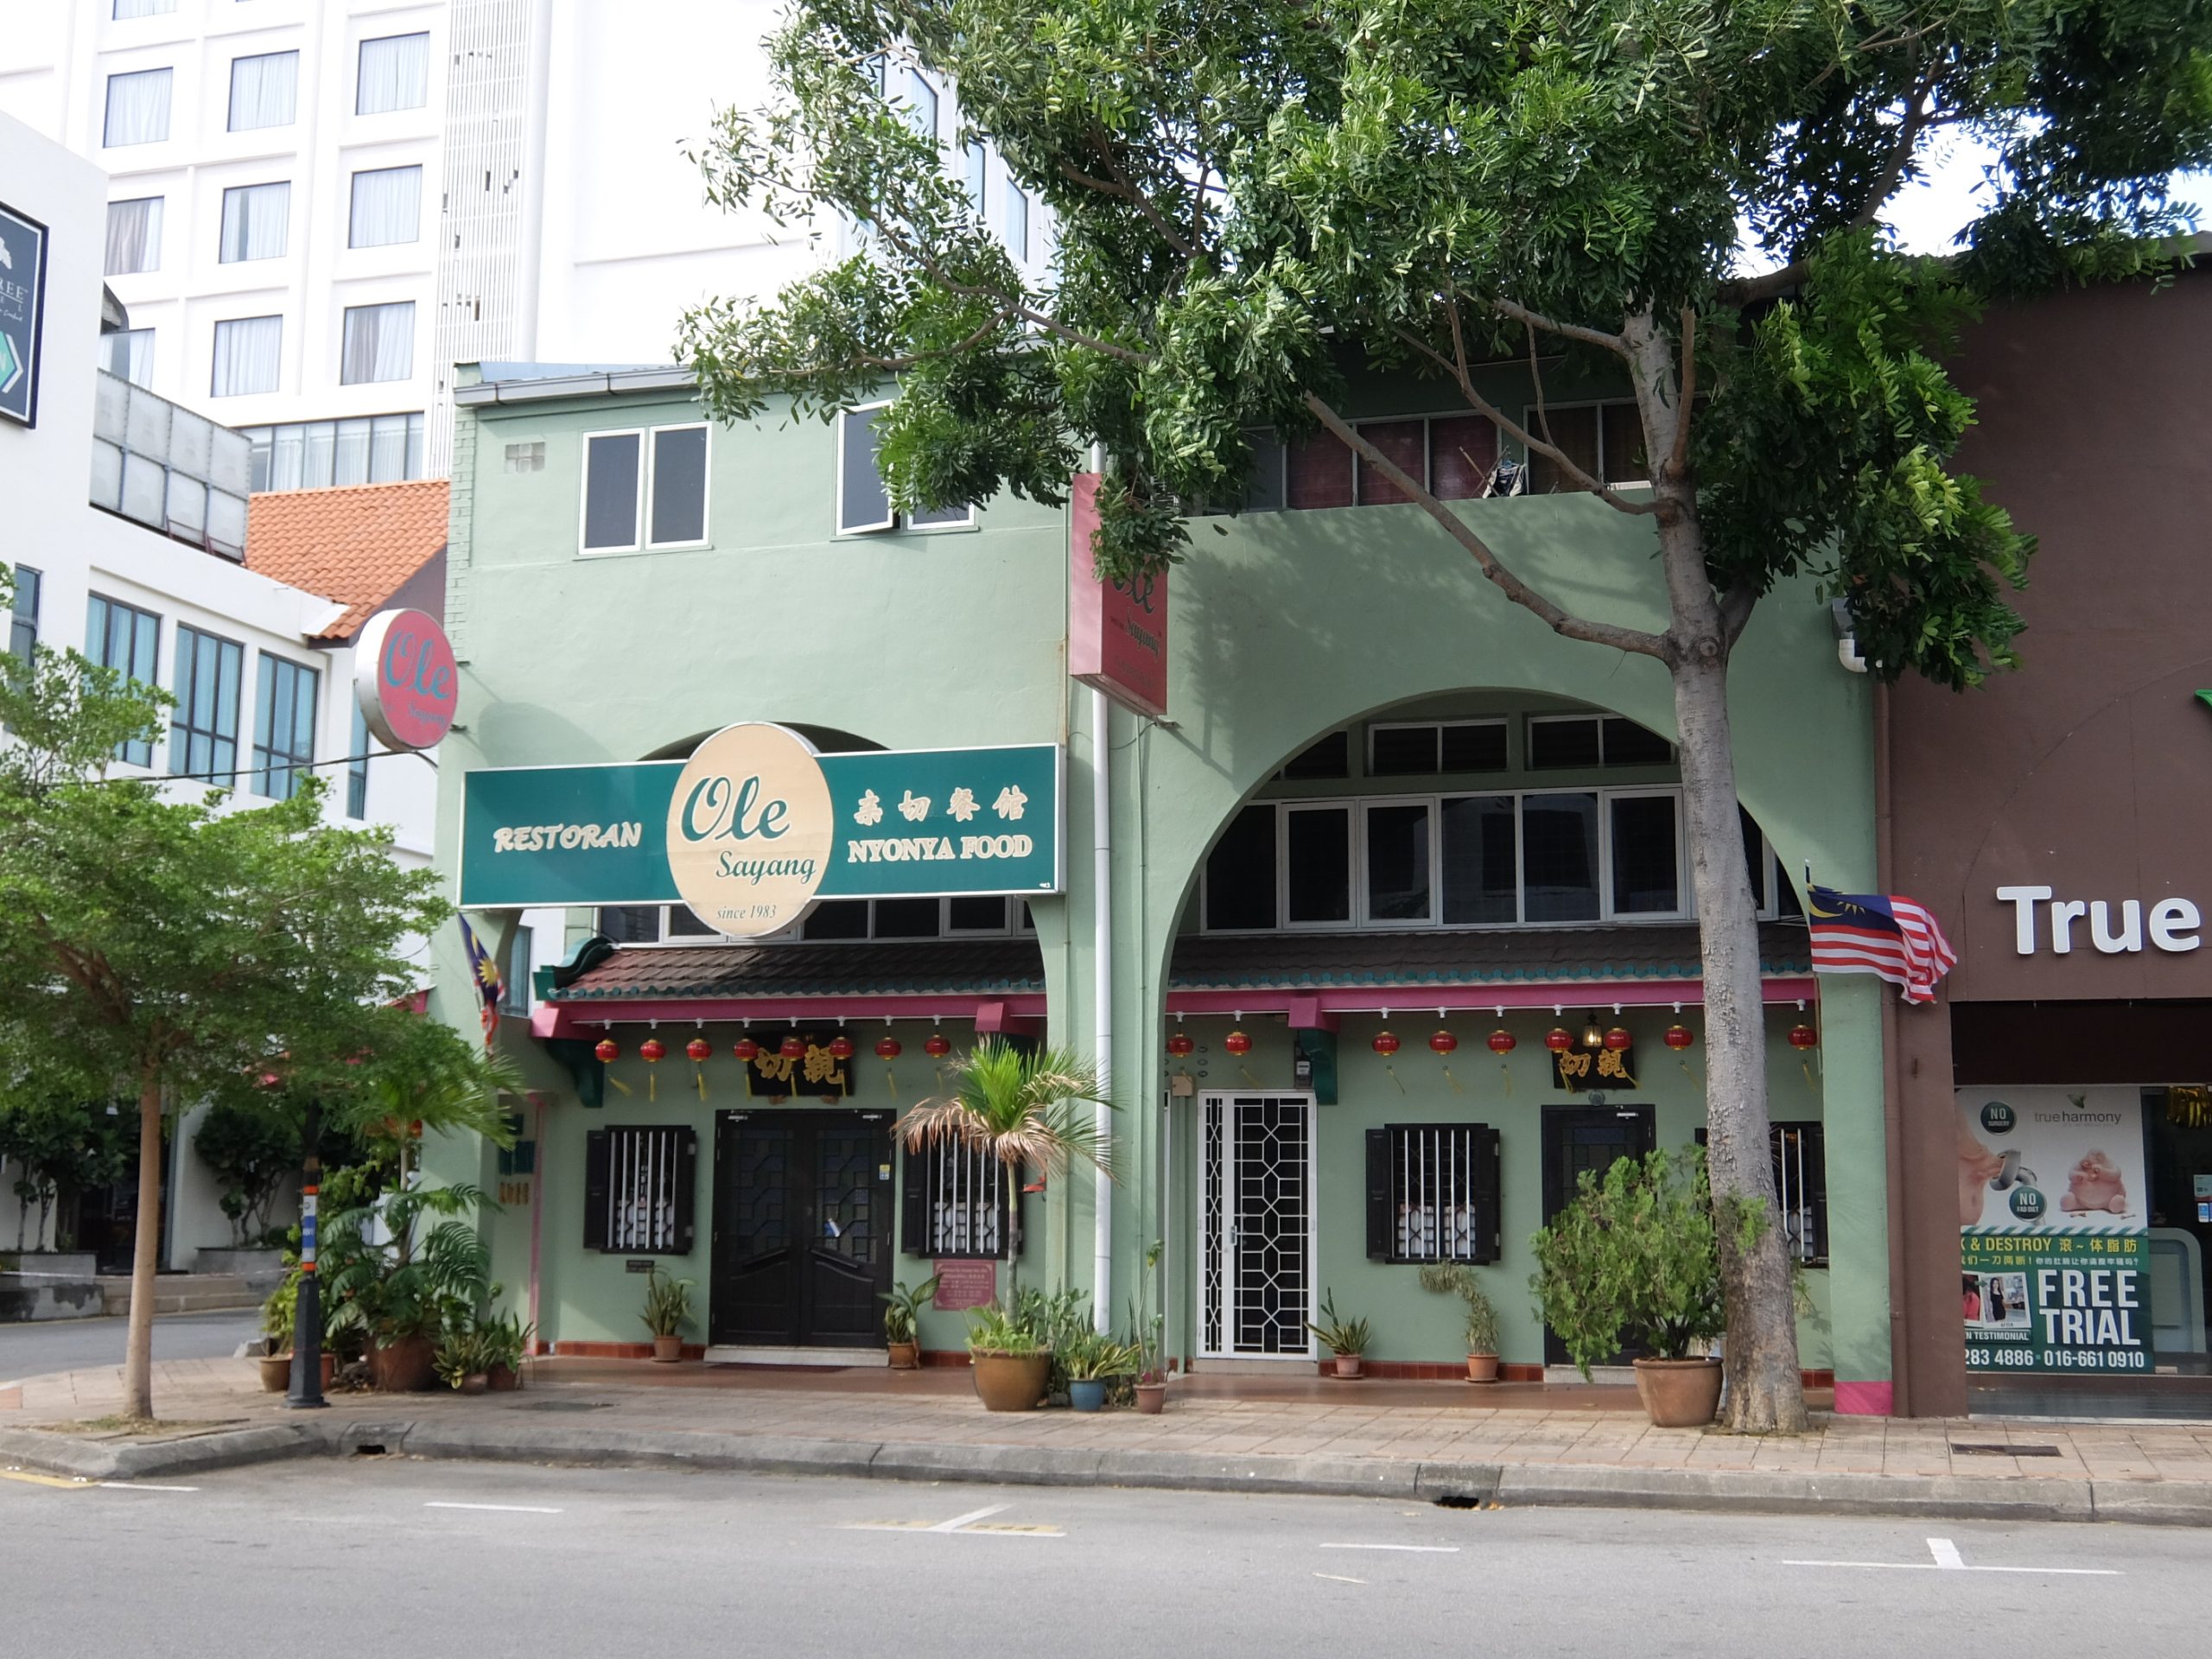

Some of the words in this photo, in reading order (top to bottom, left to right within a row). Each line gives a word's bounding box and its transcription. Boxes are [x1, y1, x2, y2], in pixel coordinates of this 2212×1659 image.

[385, 630, 450, 700] Ole
[681, 775, 791, 842] Ole
[854, 785, 1028, 826] 亲切餐馆
[493, 821, 642, 854] RESTORAN
[848, 836, 956, 862] NYONYA
[960, 834, 1033, 859] FOOD
[715, 850, 817, 886] Sayang
[716, 906, 746, 919] since
[749, 905, 777, 918] 1983
[1997, 886, 2202, 956] True
[1990, 1108, 2006, 1121] NO
[2019, 1193, 2037, 1205] NO
[1970, 1237, 1980, 1251] &
[1986, 1237, 2051, 1252] DESTROY
[2037, 1269, 2139, 1307] FREE
[1974, 1332, 2029, 1341] TESTIMONIAL
[2039, 1308, 2141, 1345] TRIAL
[1994, 1350, 2034, 1366] 4886
[2044, 1351, 2104, 1367] 016-661
[2108, 1351, 2145, 1368] 0910
